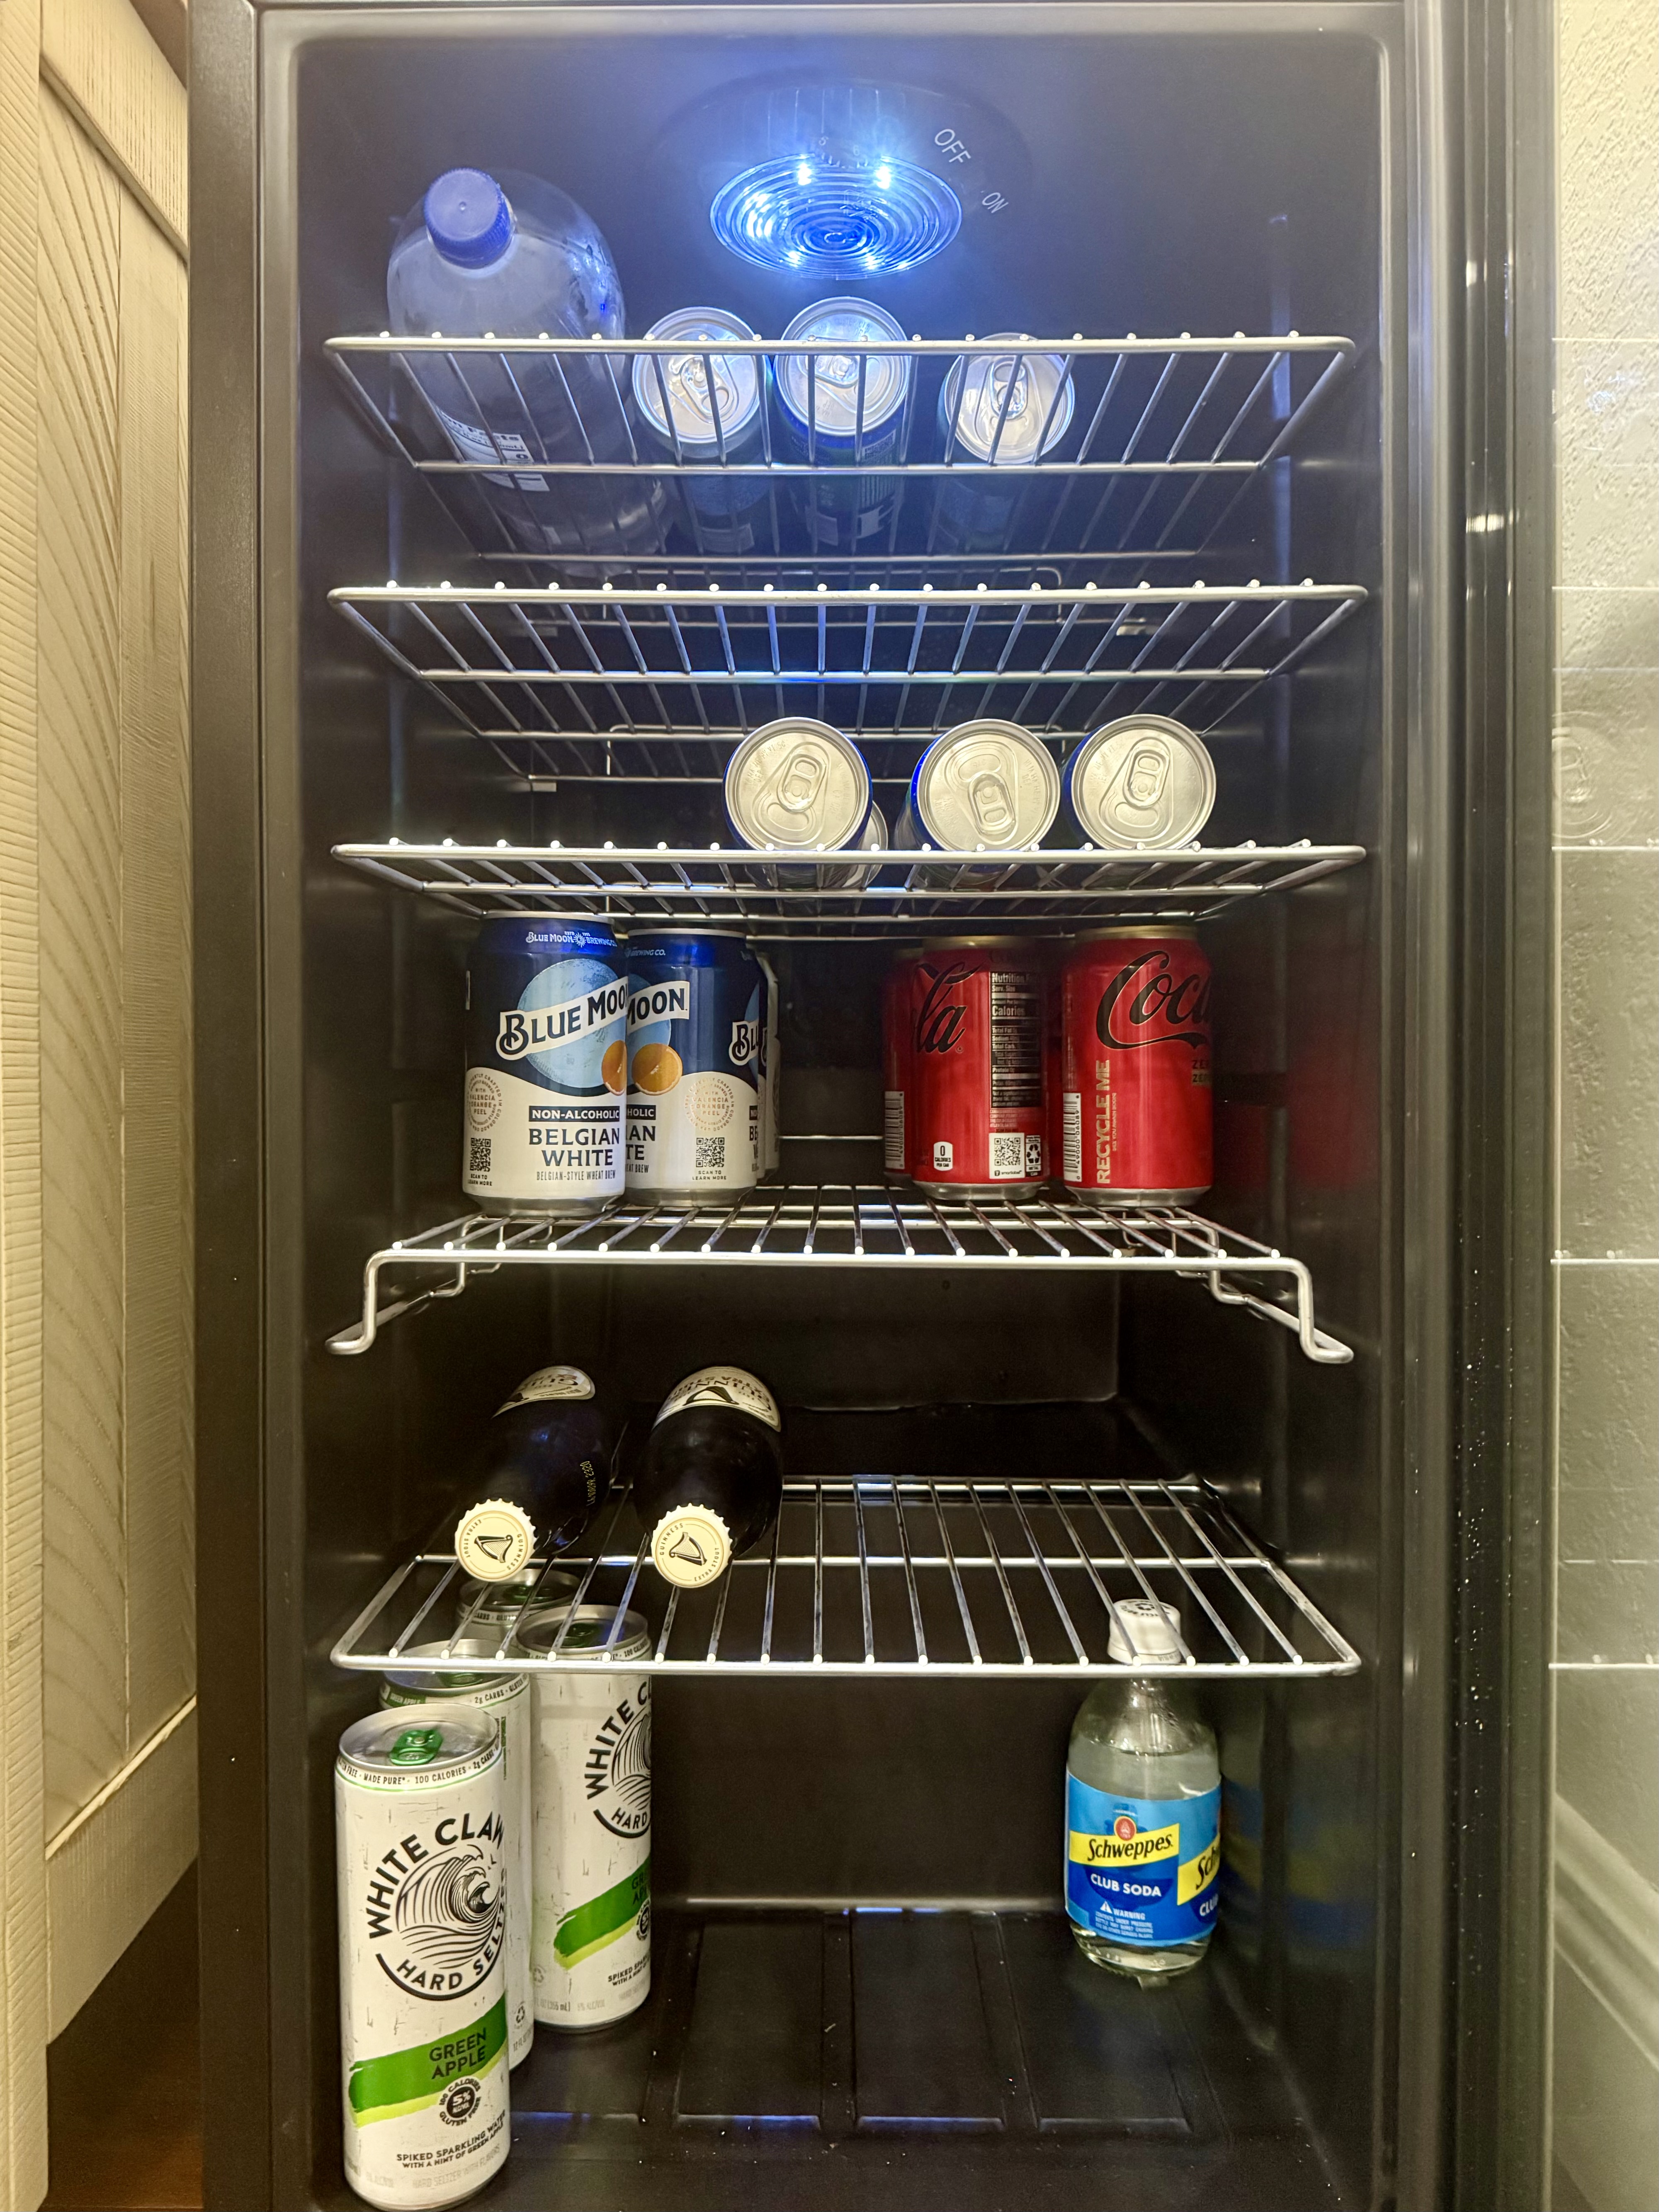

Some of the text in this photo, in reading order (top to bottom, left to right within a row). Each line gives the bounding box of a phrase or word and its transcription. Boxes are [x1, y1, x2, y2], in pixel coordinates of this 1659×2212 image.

[935, 129, 971, 163] OFF
[982, 192, 1008, 213] ON
[526, 932, 548, 943] BLUE
[550, 933, 574, 943] MOON
[585, 937, 611, 946] BREWING
[992, 972, 1025, 983] Nutrition
[499, 983, 628, 1054] BLUE MOO
[992, 1005, 1026, 1016] Calories
[717, 1079, 734, 1099] CRAFTED
[532, 1110, 619, 1119] NON-ALCOHOLIC
[713, 1110, 734, 1131] COLORADO
[1096, 1060, 1110, 1184] RECYCLE ME
[529, 1128, 620, 1146] BELGIAN
[542, 1149, 613, 1166] WHITE
[940, 1145, 945, 1156] 0
[537, 1171, 584, 1180] BELGIAN-STYLE
[586, 1170, 603, 1180] WHEAT
[635, 1164, 649, 1173] BREW
[466, 1519, 482, 1535] EXTRA
[660, 1523, 683, 1555] GUINNESS
[507, 1534, 523, 1570] GUINNESS
[694, 1547, 719, 1581] EXTRA STOUT
[485, 1689, 504, 1701] CARBS
[584, 1699, 634, 1800] WHITE
[346, 1765, 357, 1777] FREE
[363, 1773, 381, 1783] MADE
[432, 1768, 466, 1781] CALORIES
[472, 1761, 481, 1770] 2g
[611, 1807, 648, 1829] HARD
[1087, 1833, 1173, 1862] Schweppes
[365, 1811, 504, 1939] WHITE CLAW
[1091, 1873, 1162, 1897] CLUB SODA
[1113, 1908, 1146, 1921] WARNING
[396, 1959, 463, 1991] HARD
[607, 1966, 633, 1982] SPIKED
[612, 1978, 627, 1986] WITH
[430, 2027, 486, 2062] GREEN
[431, 2045, 486, 2079] APPLE
[439, 2078, 481, 2106] 100 CALORIES
[452, 2090, 471, 2107] 5%
[440, 2096, 482, 2126] GLUTEN FREE
[396, 2152, 433, 2161] SPIKED
[436, 2130, 486, 2158] SPARKLING
[434, 2156, 453, 2166] HINT
[456, 2151, 466, 2159] OF
[467, 2139, 489, 2153] GREEN
